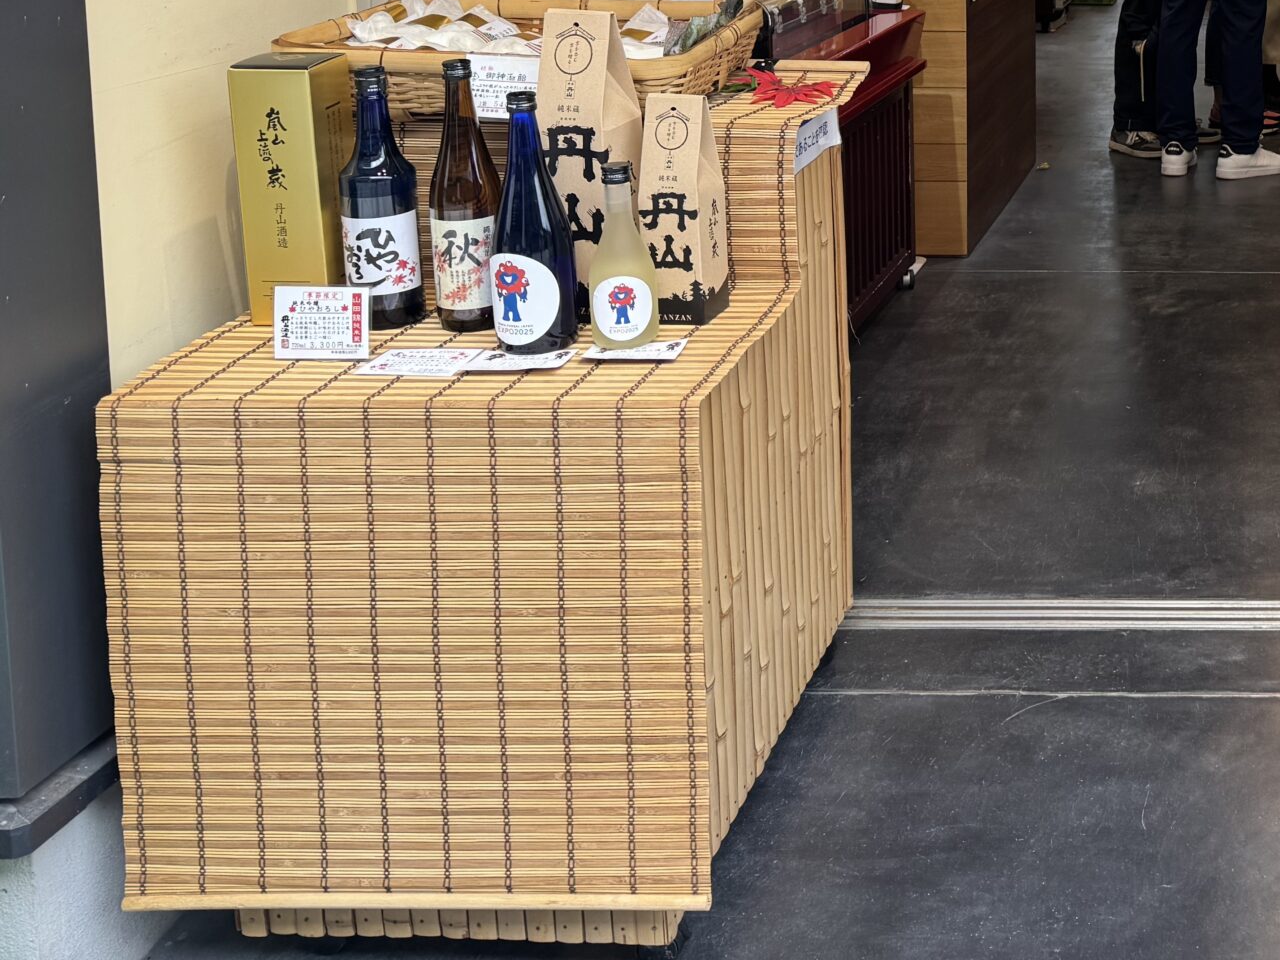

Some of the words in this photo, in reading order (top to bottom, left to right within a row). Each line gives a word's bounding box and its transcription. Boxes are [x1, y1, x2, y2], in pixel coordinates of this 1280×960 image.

[274, 202, 288, 249] 丹山酒造
[638, 192, 698, 273] 丹山
[441, 229, 482, 269] 秋
[497, 326, 534, 336] EXPO2025
